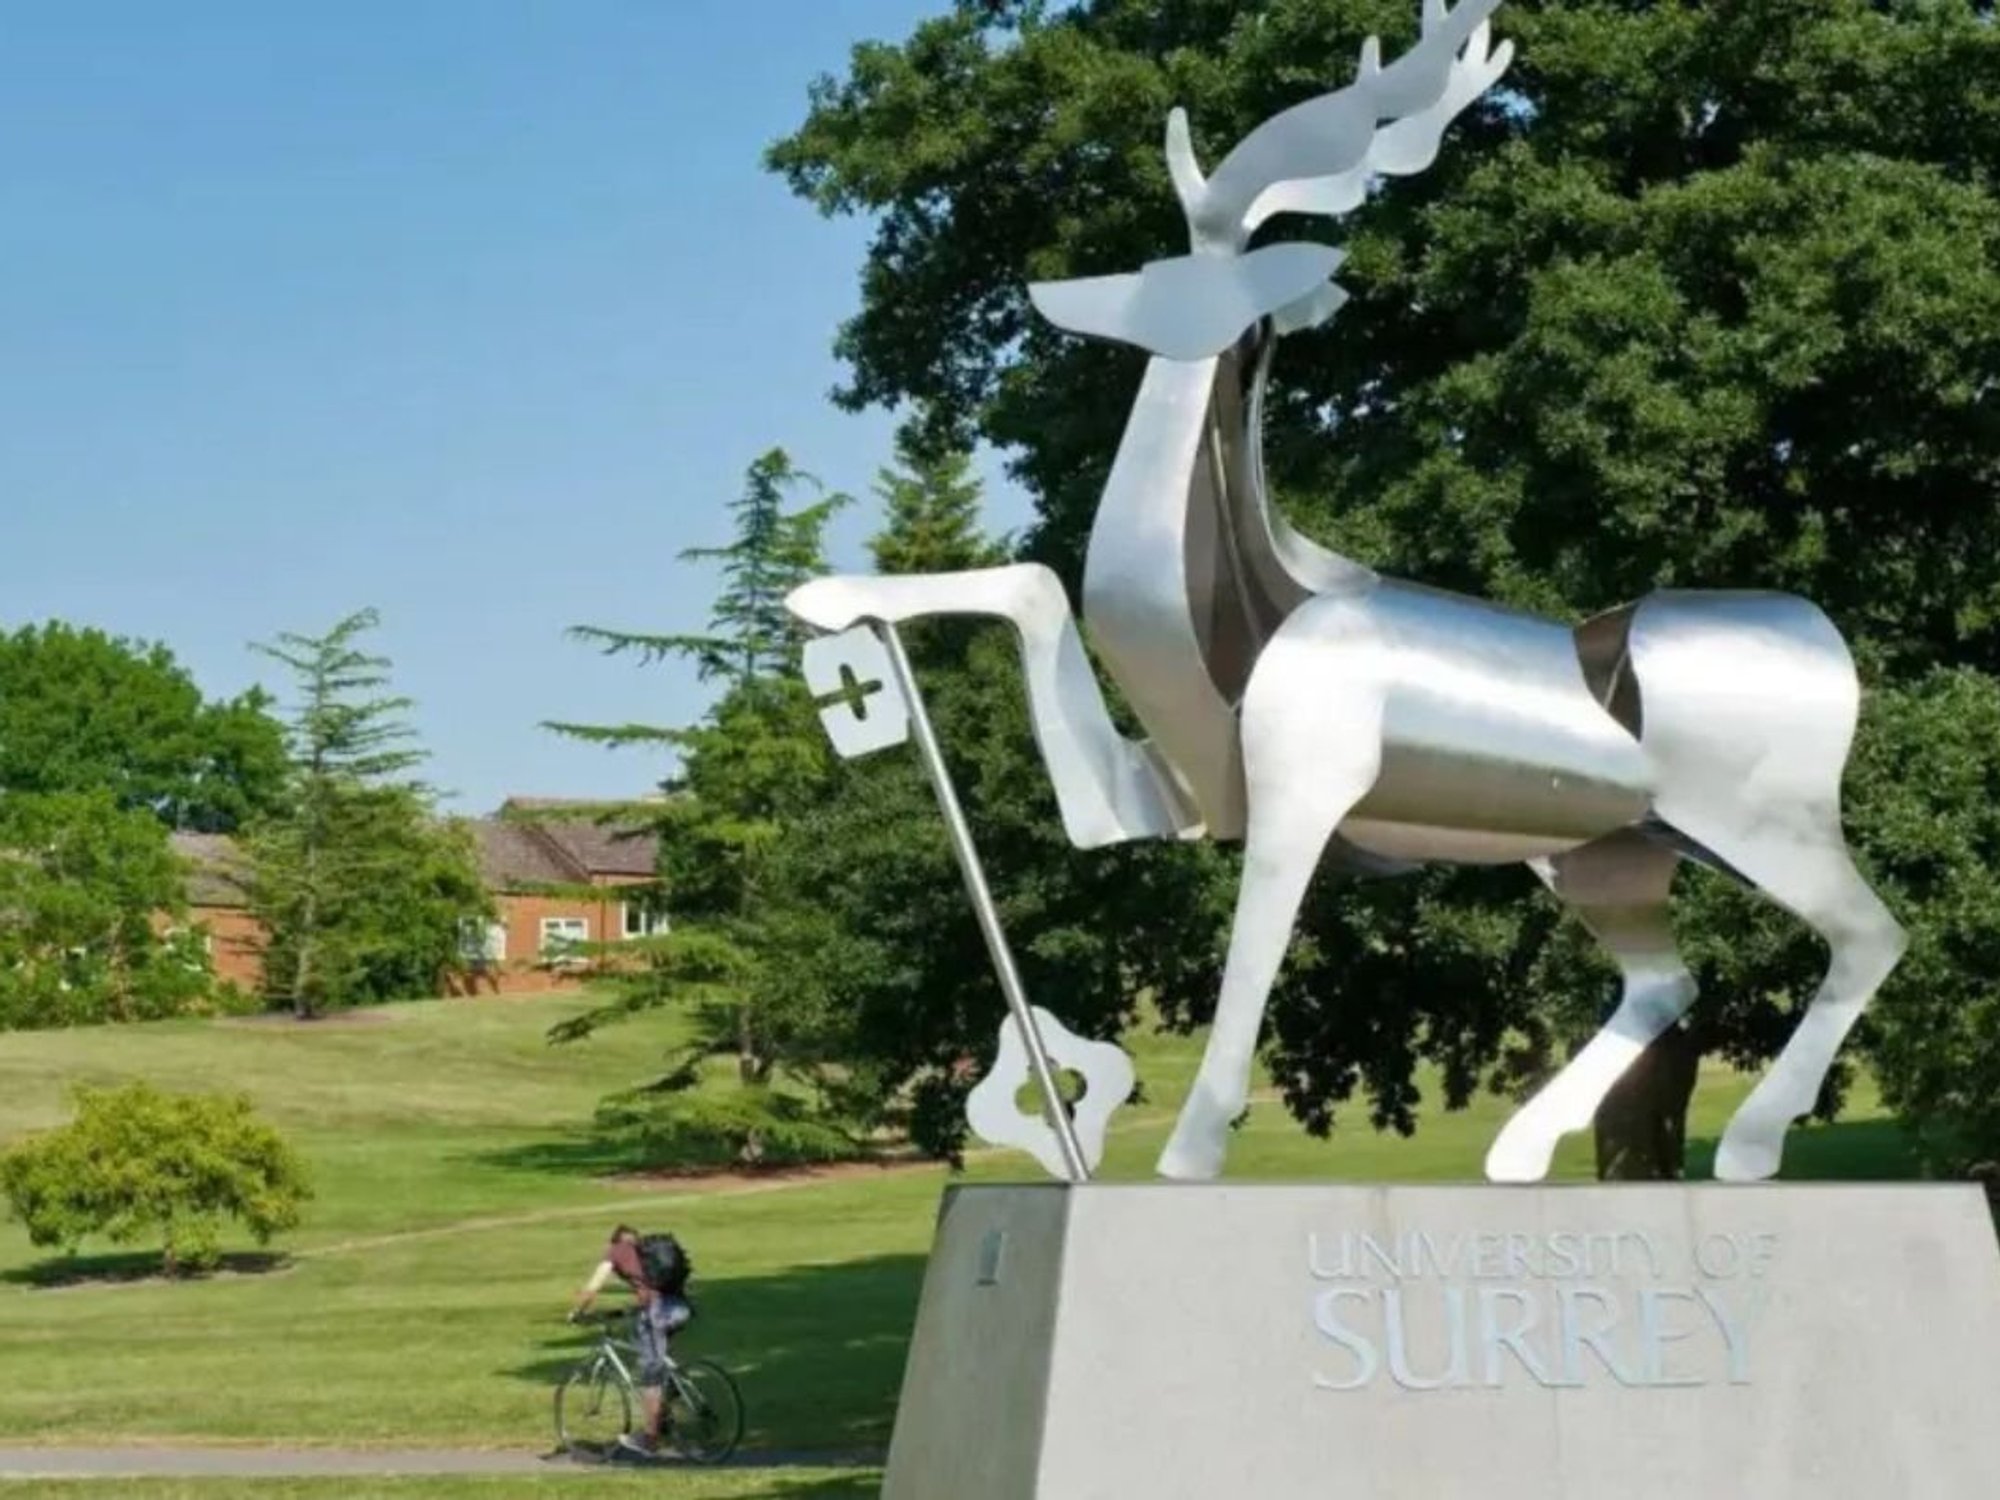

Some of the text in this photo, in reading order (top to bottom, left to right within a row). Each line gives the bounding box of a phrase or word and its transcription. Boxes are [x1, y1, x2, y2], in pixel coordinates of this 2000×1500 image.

[1307, 1231, 1779, 1281] UNIVERSITY OF
[1311, 1286, 1769, 1391] SURREY
